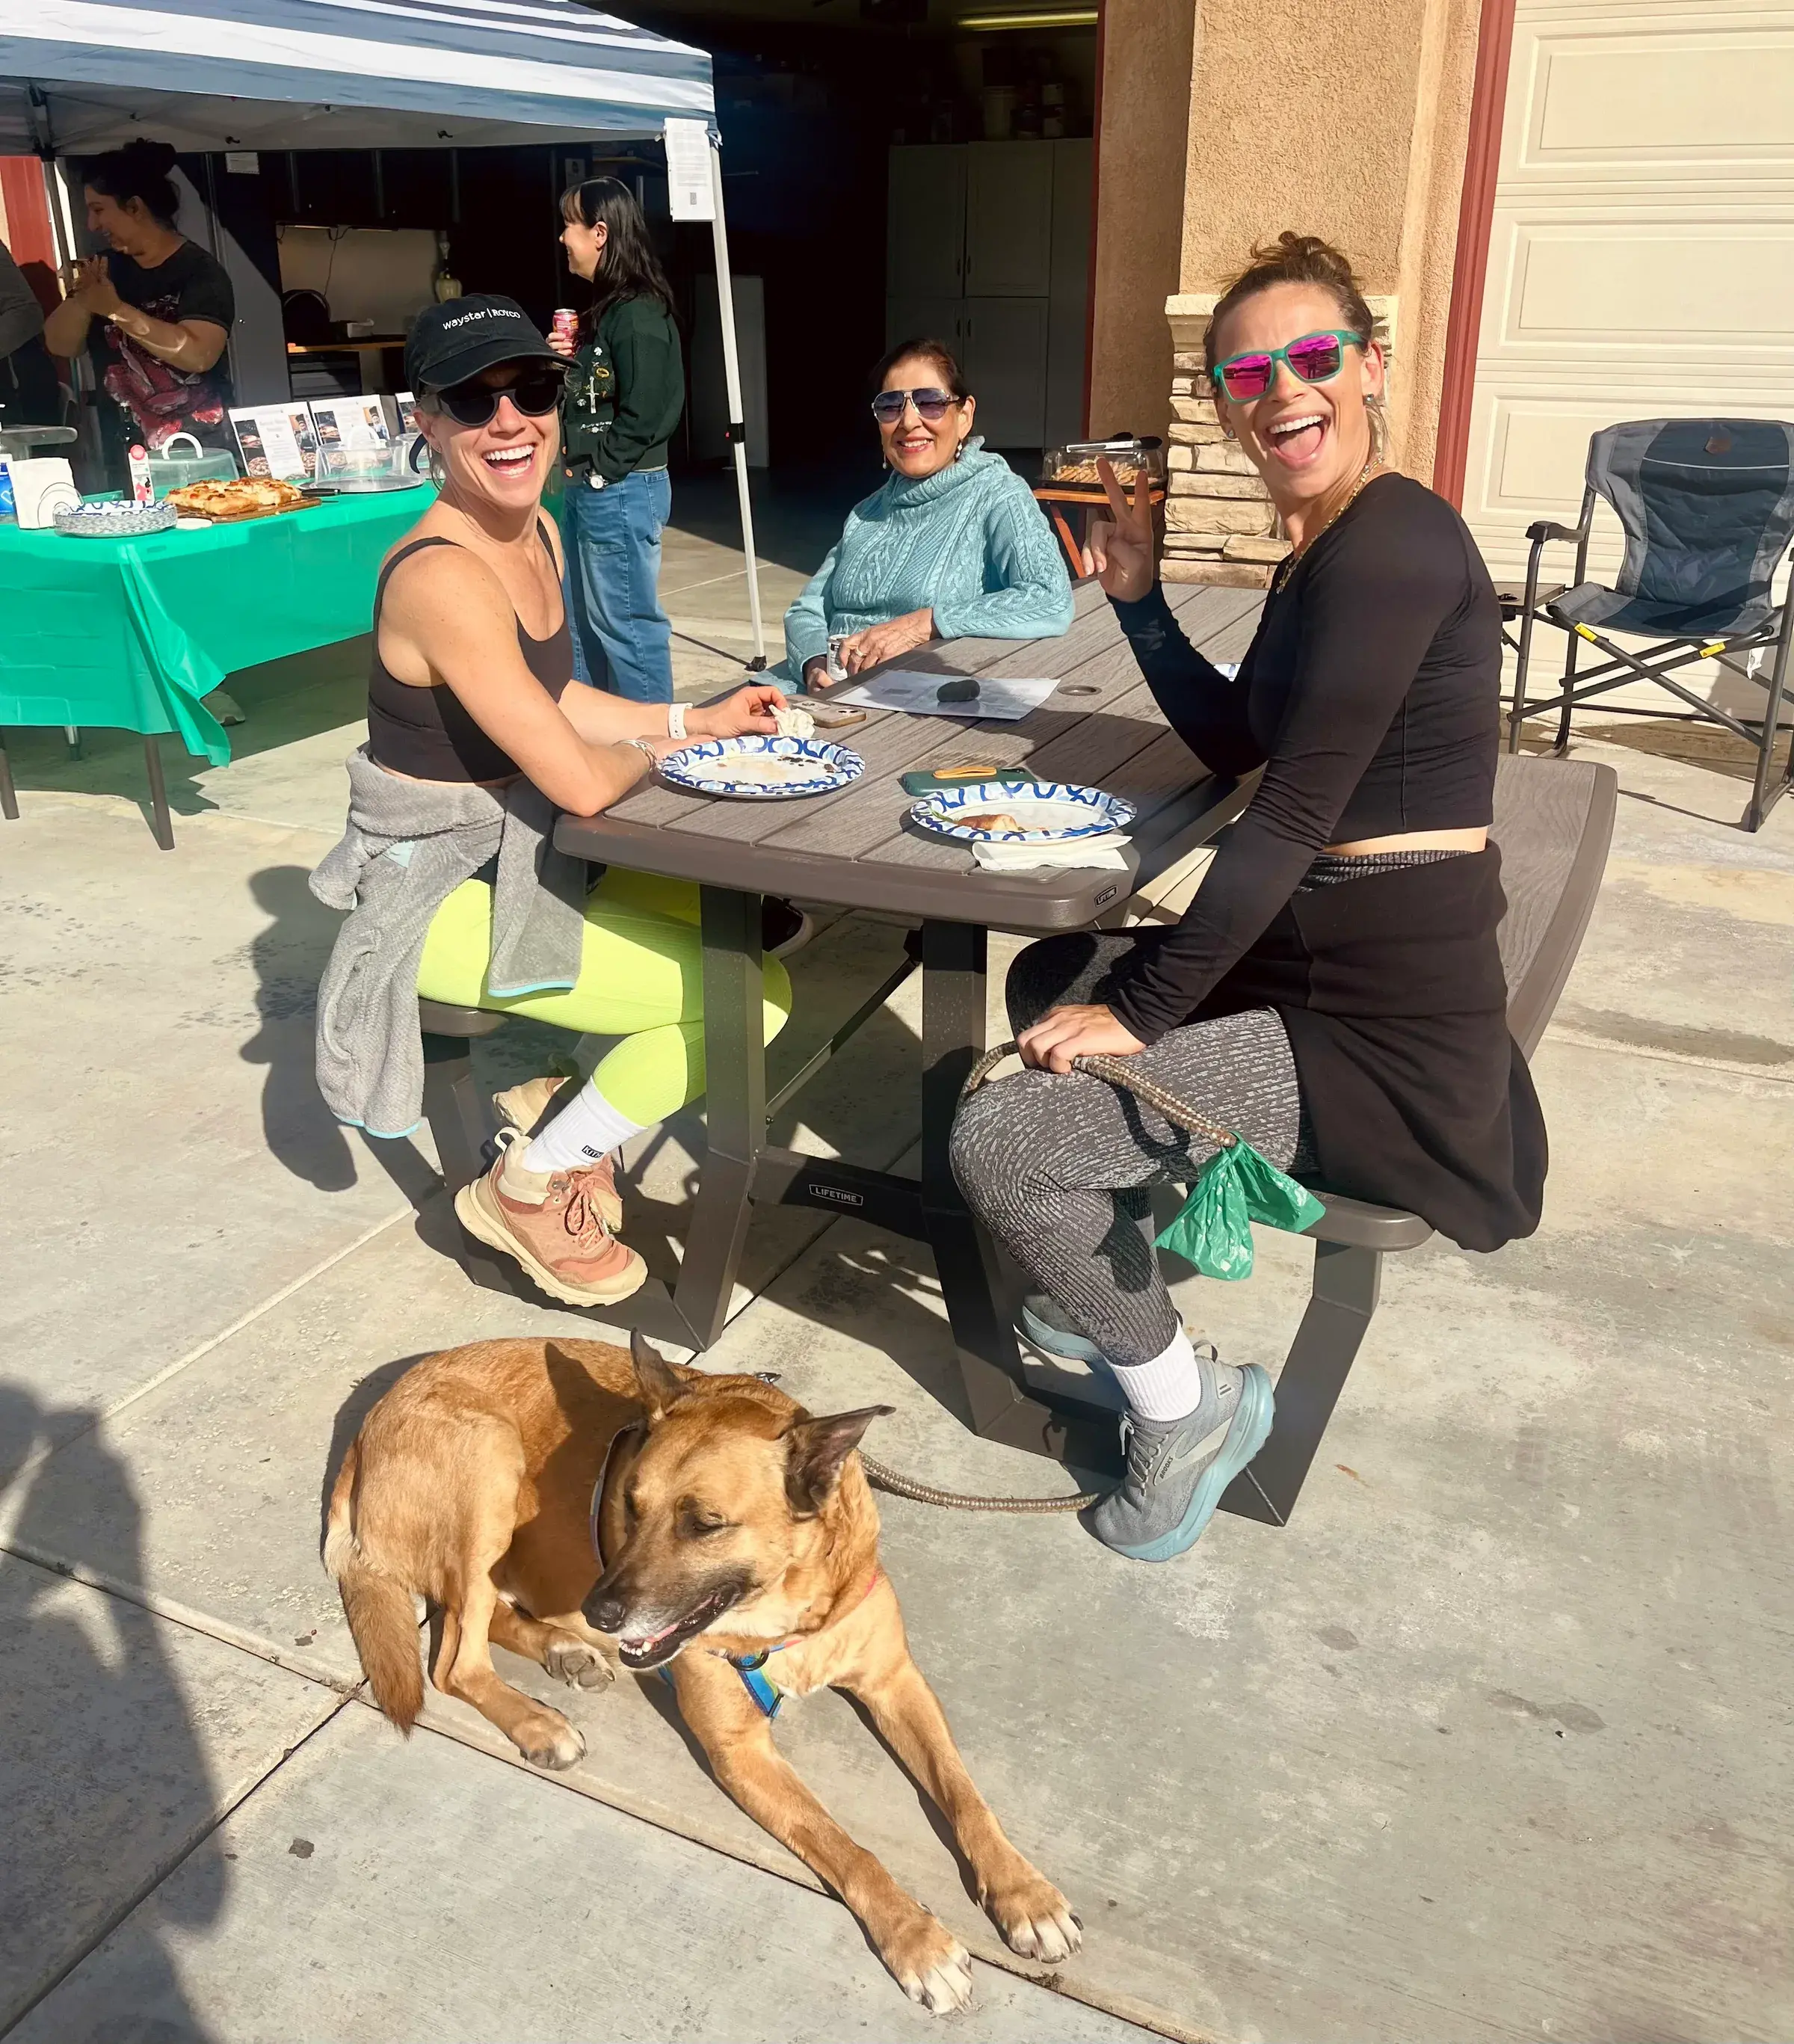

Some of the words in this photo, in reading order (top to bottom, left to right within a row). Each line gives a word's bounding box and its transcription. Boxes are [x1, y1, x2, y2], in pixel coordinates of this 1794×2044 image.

[443, 311, 486, 330] waystar
[815, 1186, 857, 1203] LIFETIME
[1159, 1455, 1174, 1480] BROOKS
